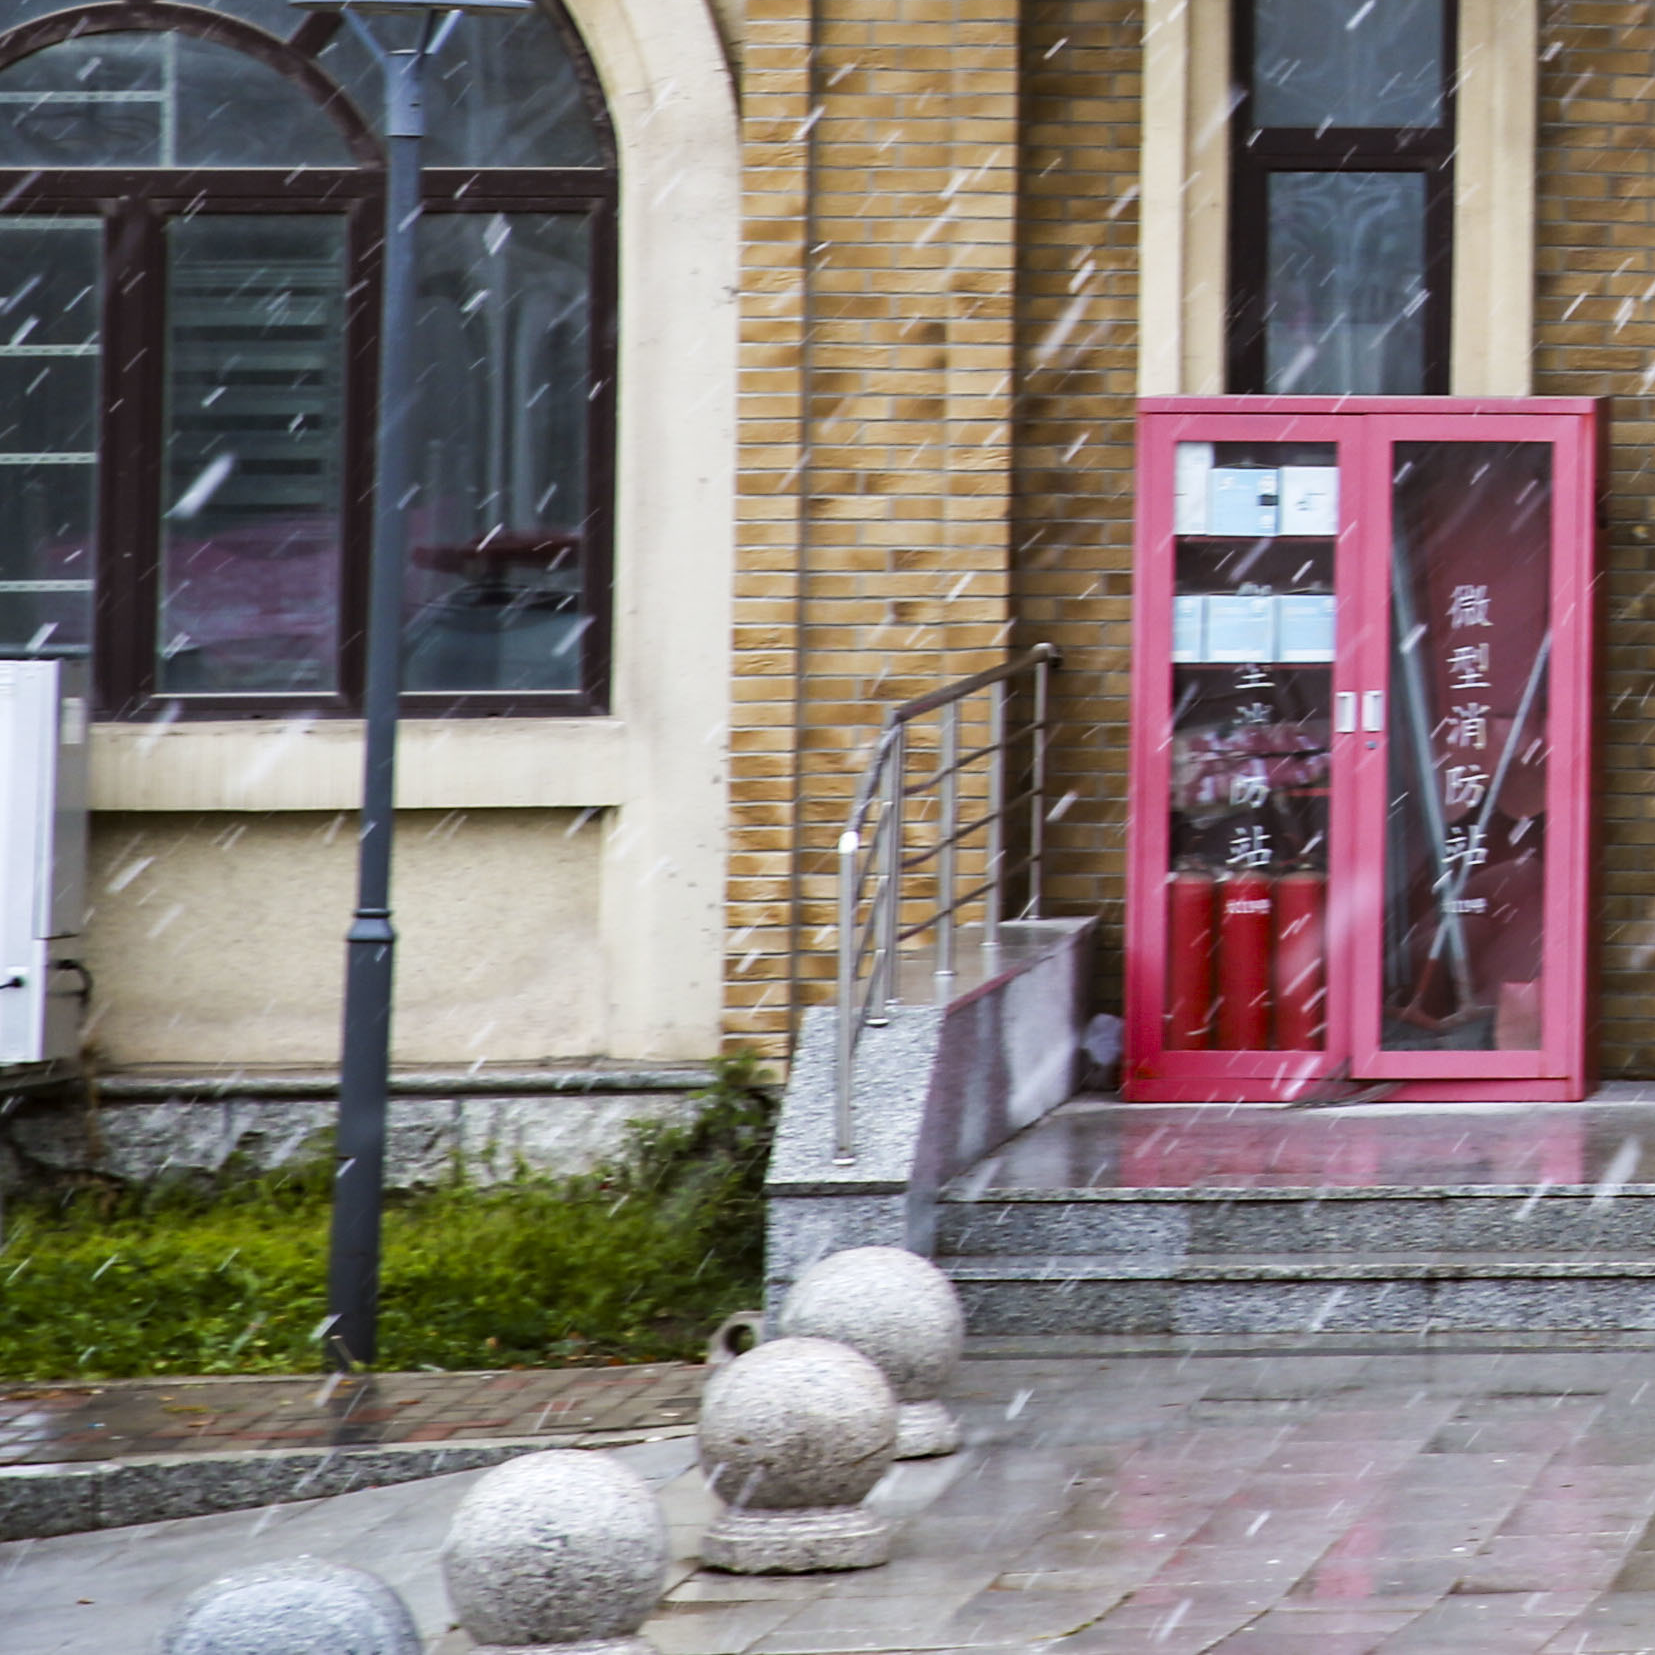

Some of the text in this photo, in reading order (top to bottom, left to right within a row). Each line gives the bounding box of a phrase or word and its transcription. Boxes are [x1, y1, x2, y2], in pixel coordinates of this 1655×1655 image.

[1440, 583, 1495, 867] 微型消防站
